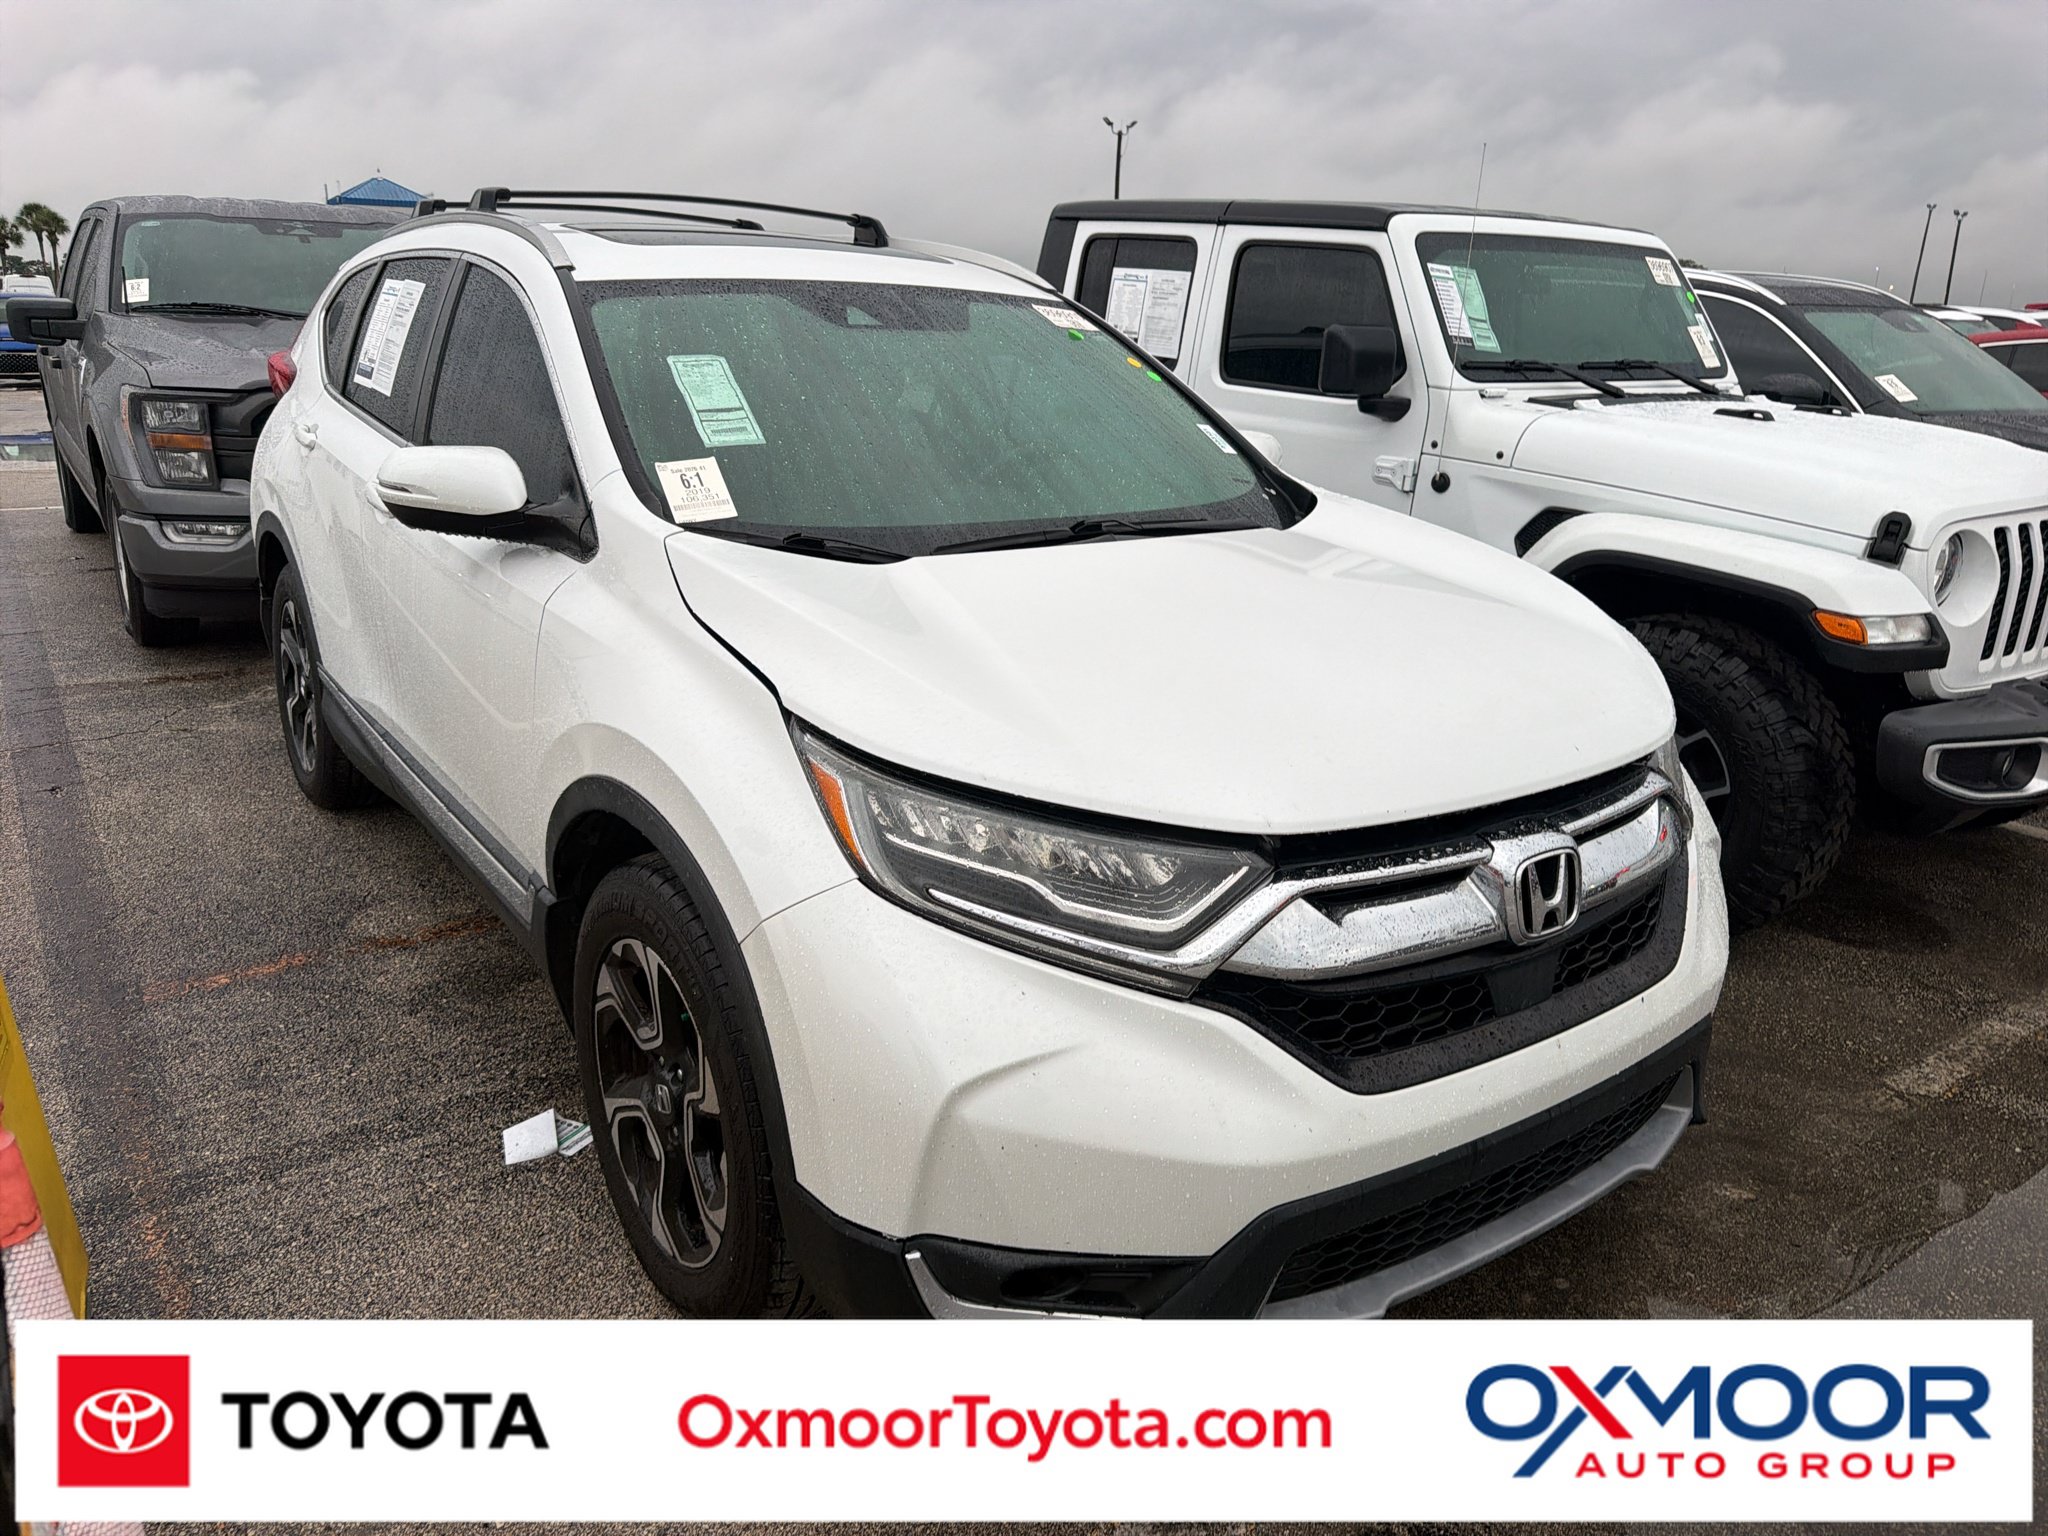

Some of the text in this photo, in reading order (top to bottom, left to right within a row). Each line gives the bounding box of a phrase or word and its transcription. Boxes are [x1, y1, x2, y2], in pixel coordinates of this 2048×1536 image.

[680, 472, 704, 489] 6:1
[684, 487, 711, 496] 2019
[681, 493, 720, 503] 106,351
